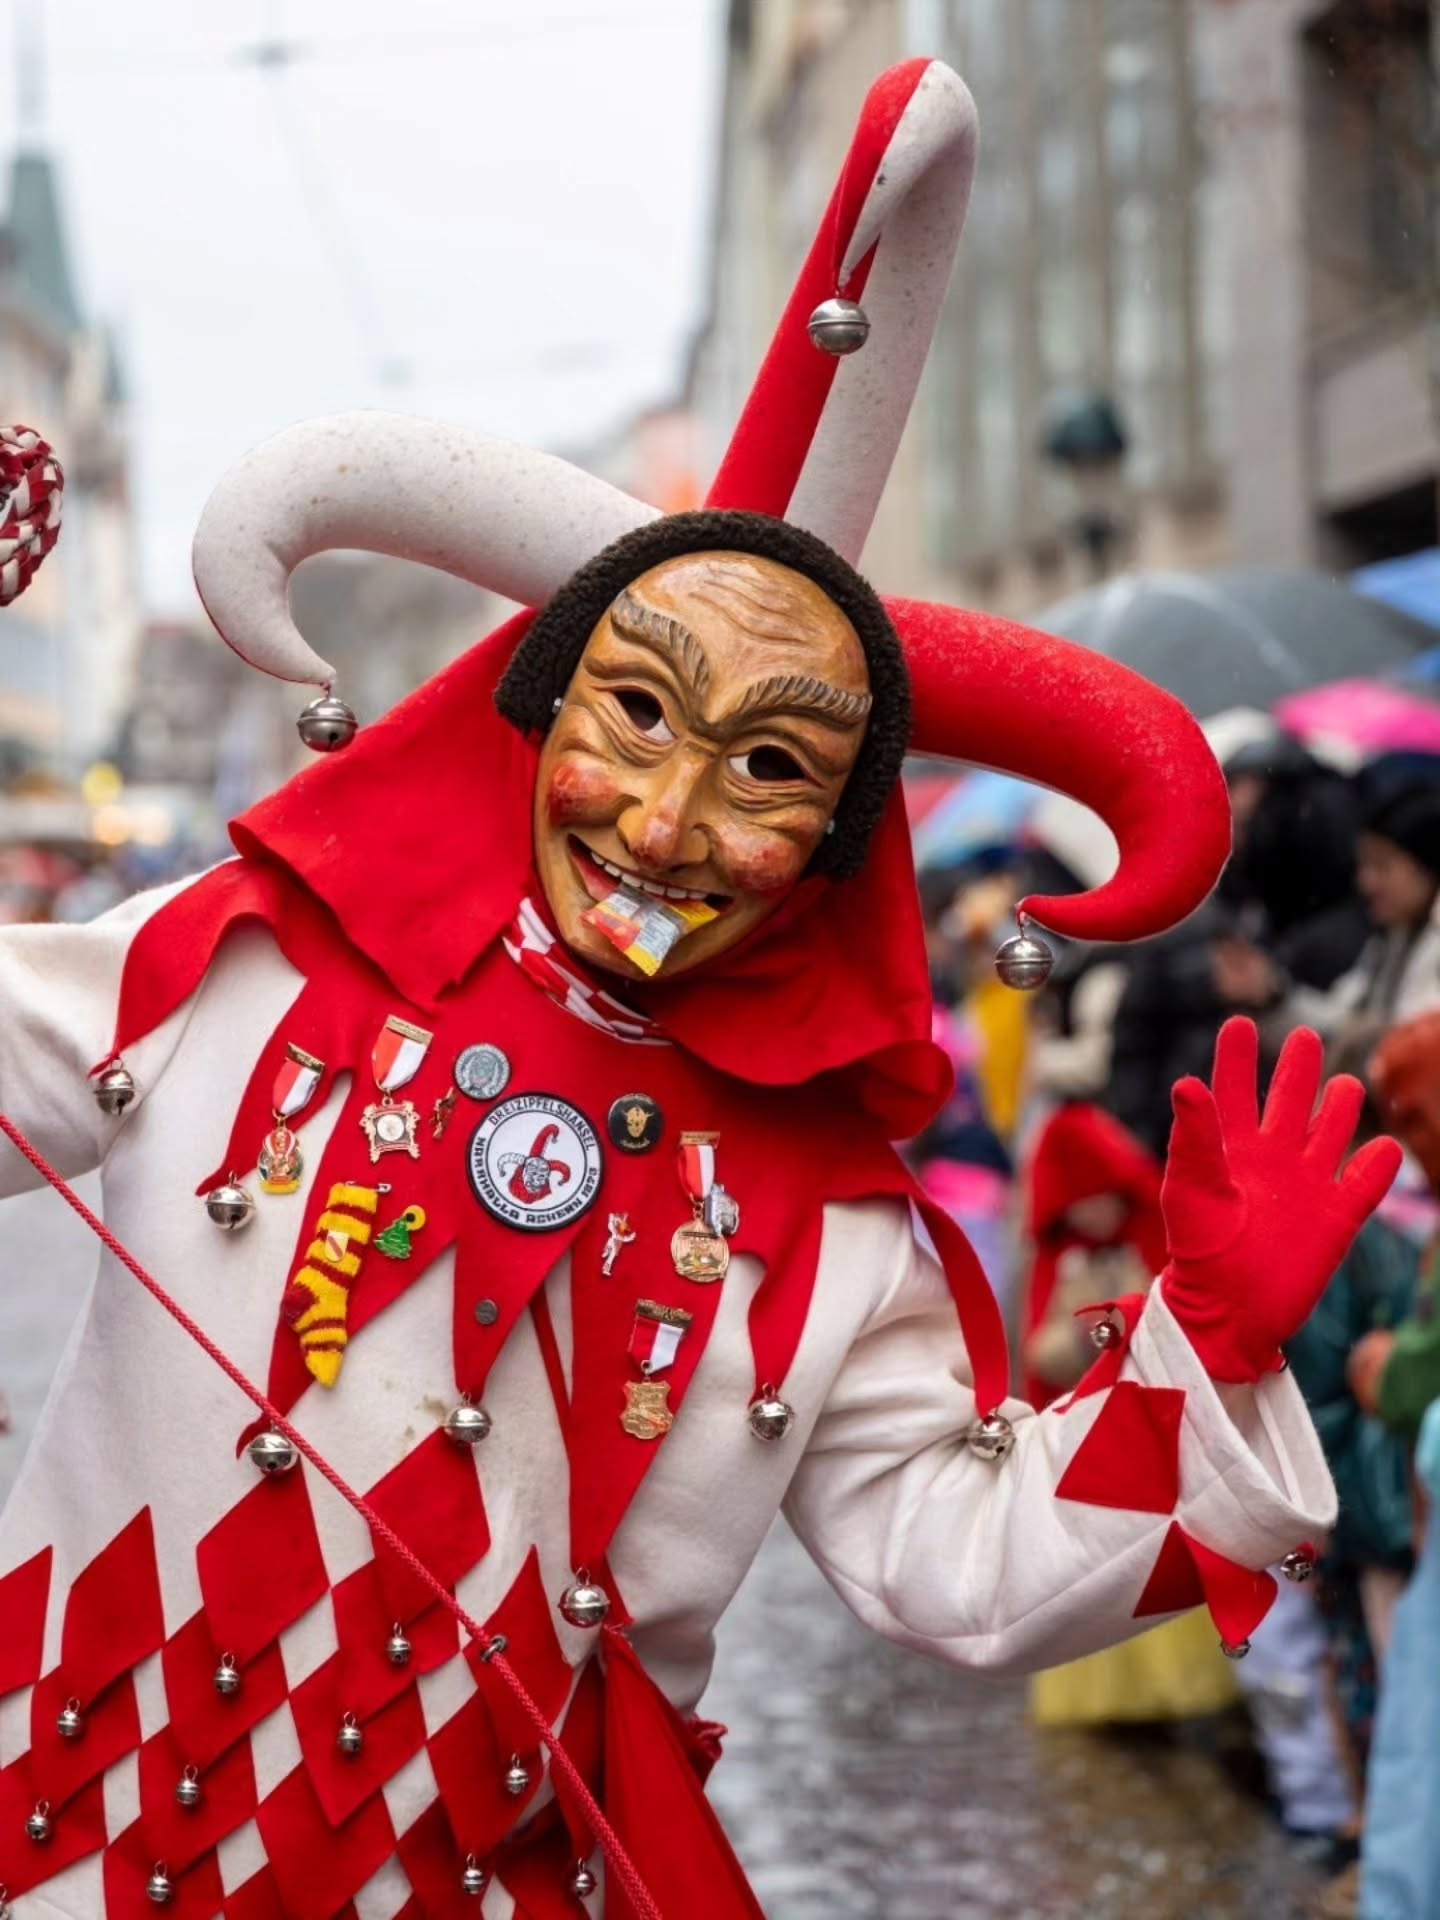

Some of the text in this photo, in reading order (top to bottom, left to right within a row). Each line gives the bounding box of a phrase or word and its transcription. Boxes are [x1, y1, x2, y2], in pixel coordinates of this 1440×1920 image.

[488, 1097, 596, 1151] DREIZIPFELSHANSEL
[474, 1136, 520, 1220] NARRHALLA
[526, 1198, 583, 1224] ACHERN
